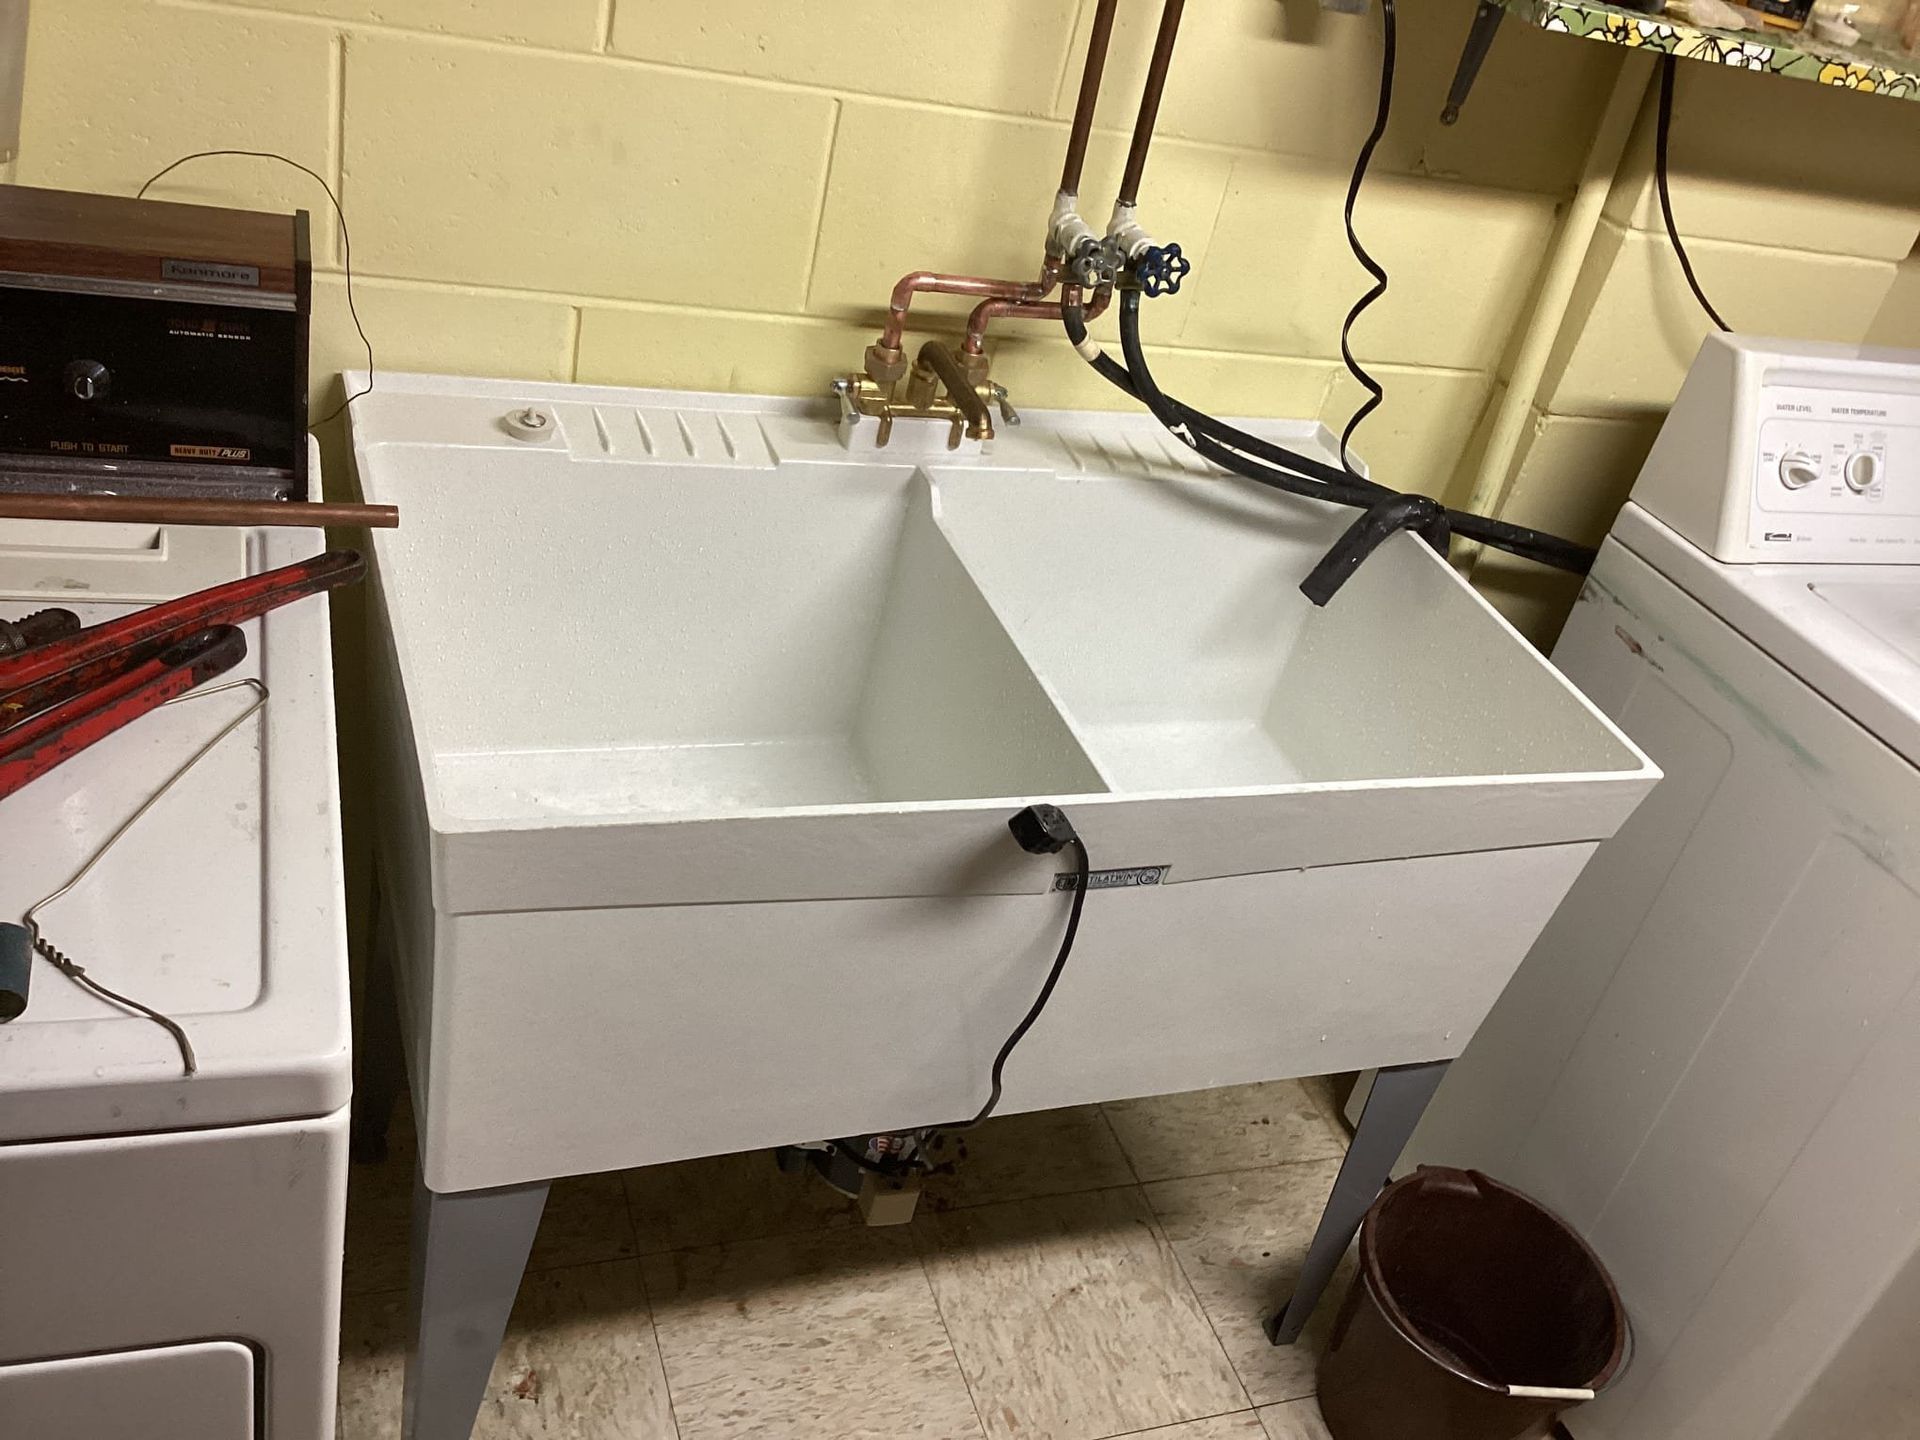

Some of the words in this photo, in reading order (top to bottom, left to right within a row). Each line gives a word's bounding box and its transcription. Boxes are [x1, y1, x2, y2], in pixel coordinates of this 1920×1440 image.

[1796, 405, 1812, 413] LEVEL
[50, 440, 78, 451] PUSH
[81, 442, 94, 452] TO
[99, 443, 129, 453] START
[221, 448, 247, 458] PLUS
